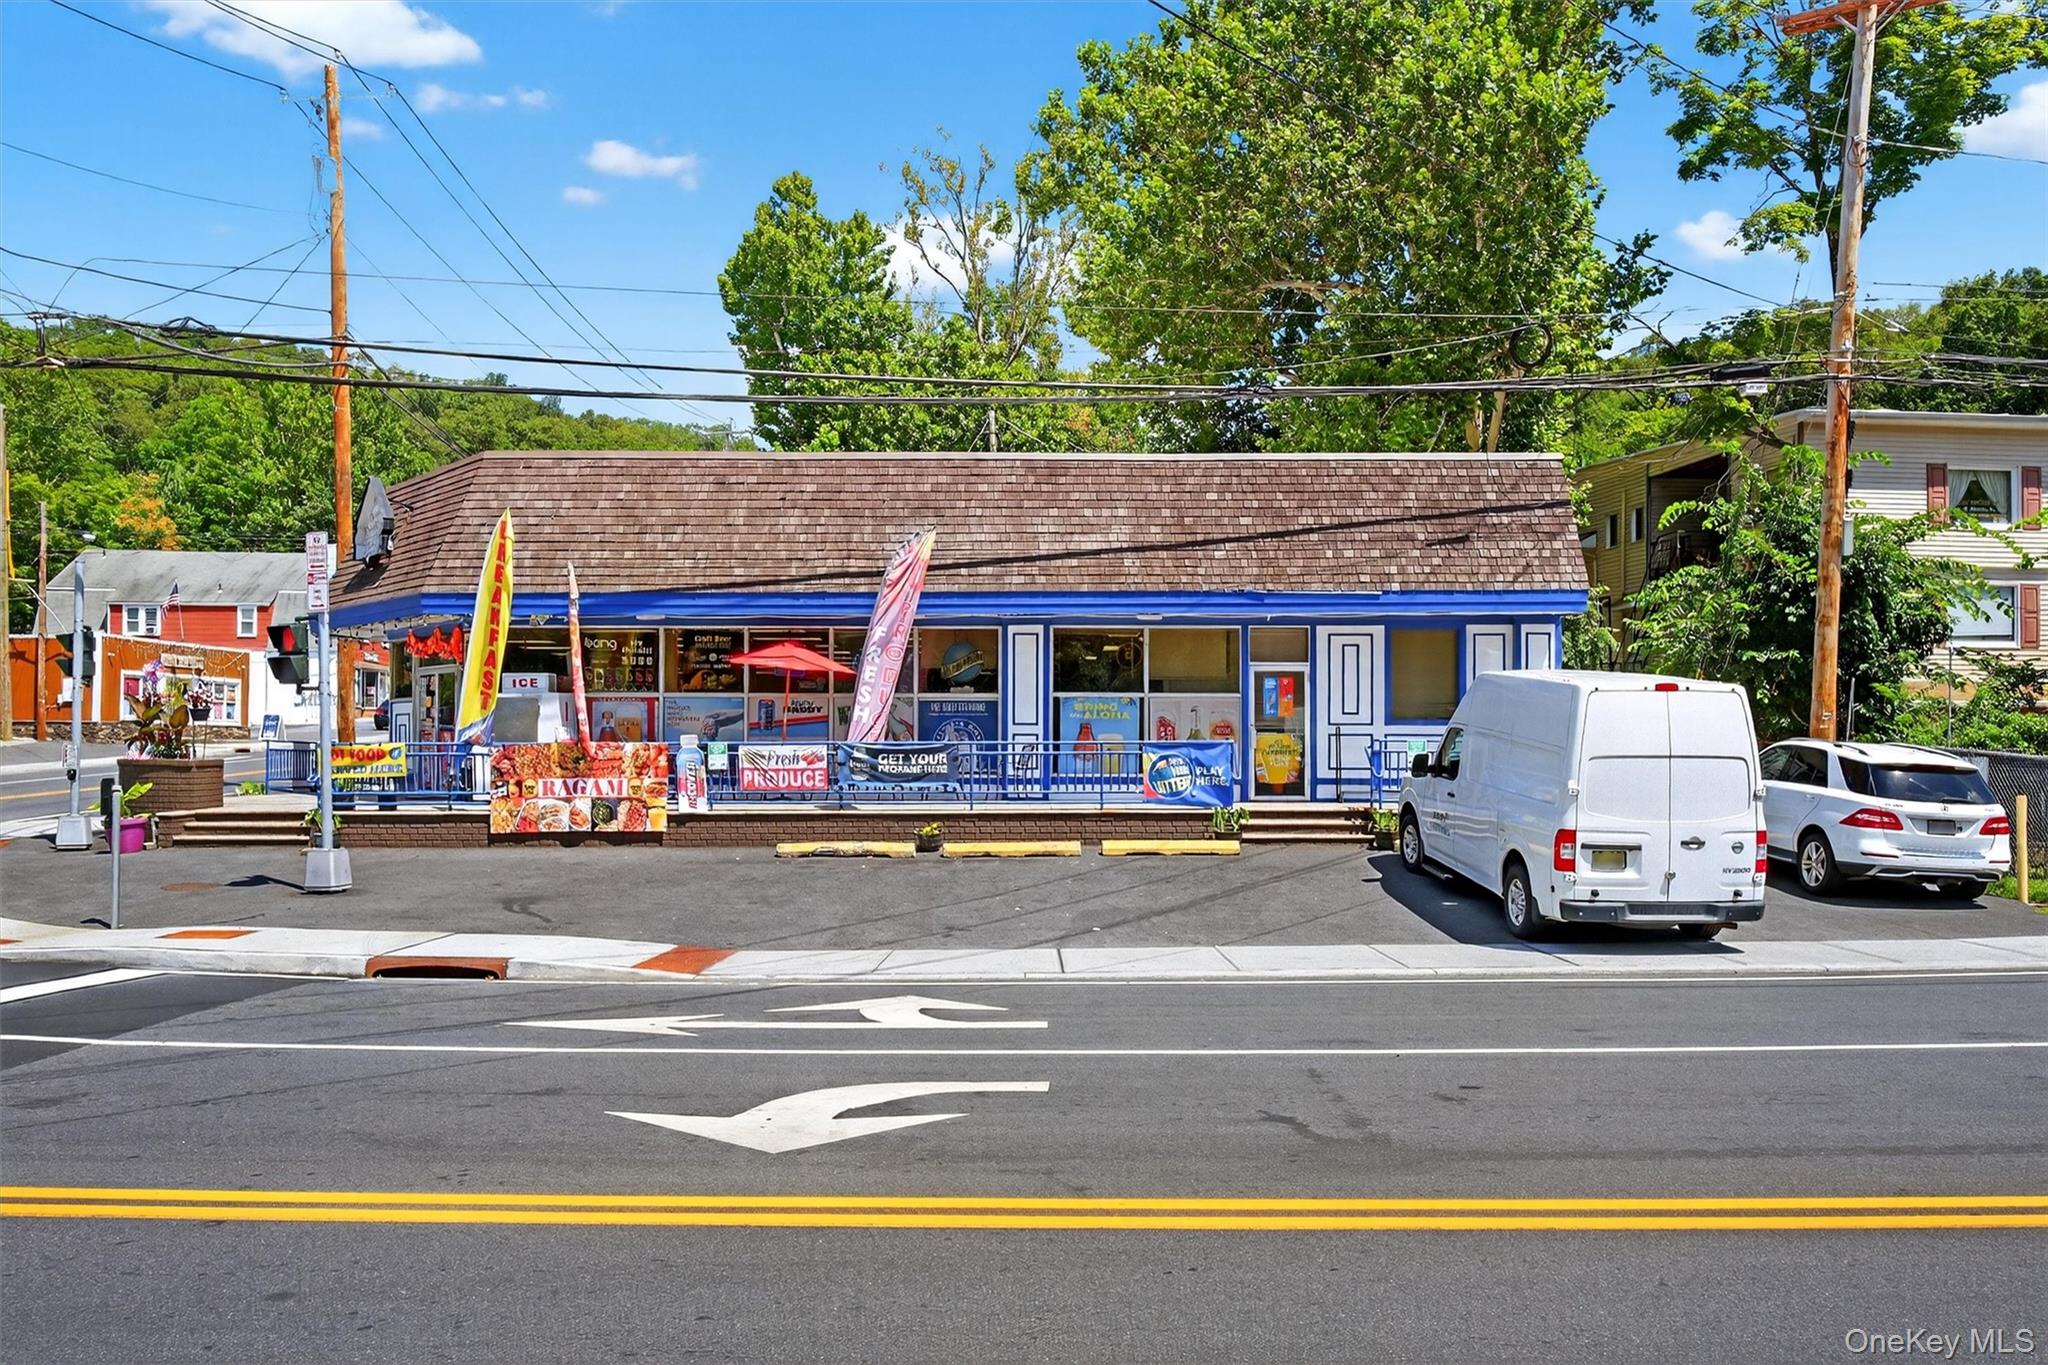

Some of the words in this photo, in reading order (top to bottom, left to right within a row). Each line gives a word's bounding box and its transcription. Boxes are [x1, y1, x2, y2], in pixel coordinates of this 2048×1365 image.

[512, 678, 538, 688] ICE
[853, 626, 887, 723] FRESH
[764, 750, 800, 767] Fresh
[878, 753, 905, 764] GET
[909, 753, 947, 765] YOUR
[743, 769, 825, 788] PRODUCE
[1195, 766, 1225, 777] PLAY
[541, 779, 624, 797] RAGAM
